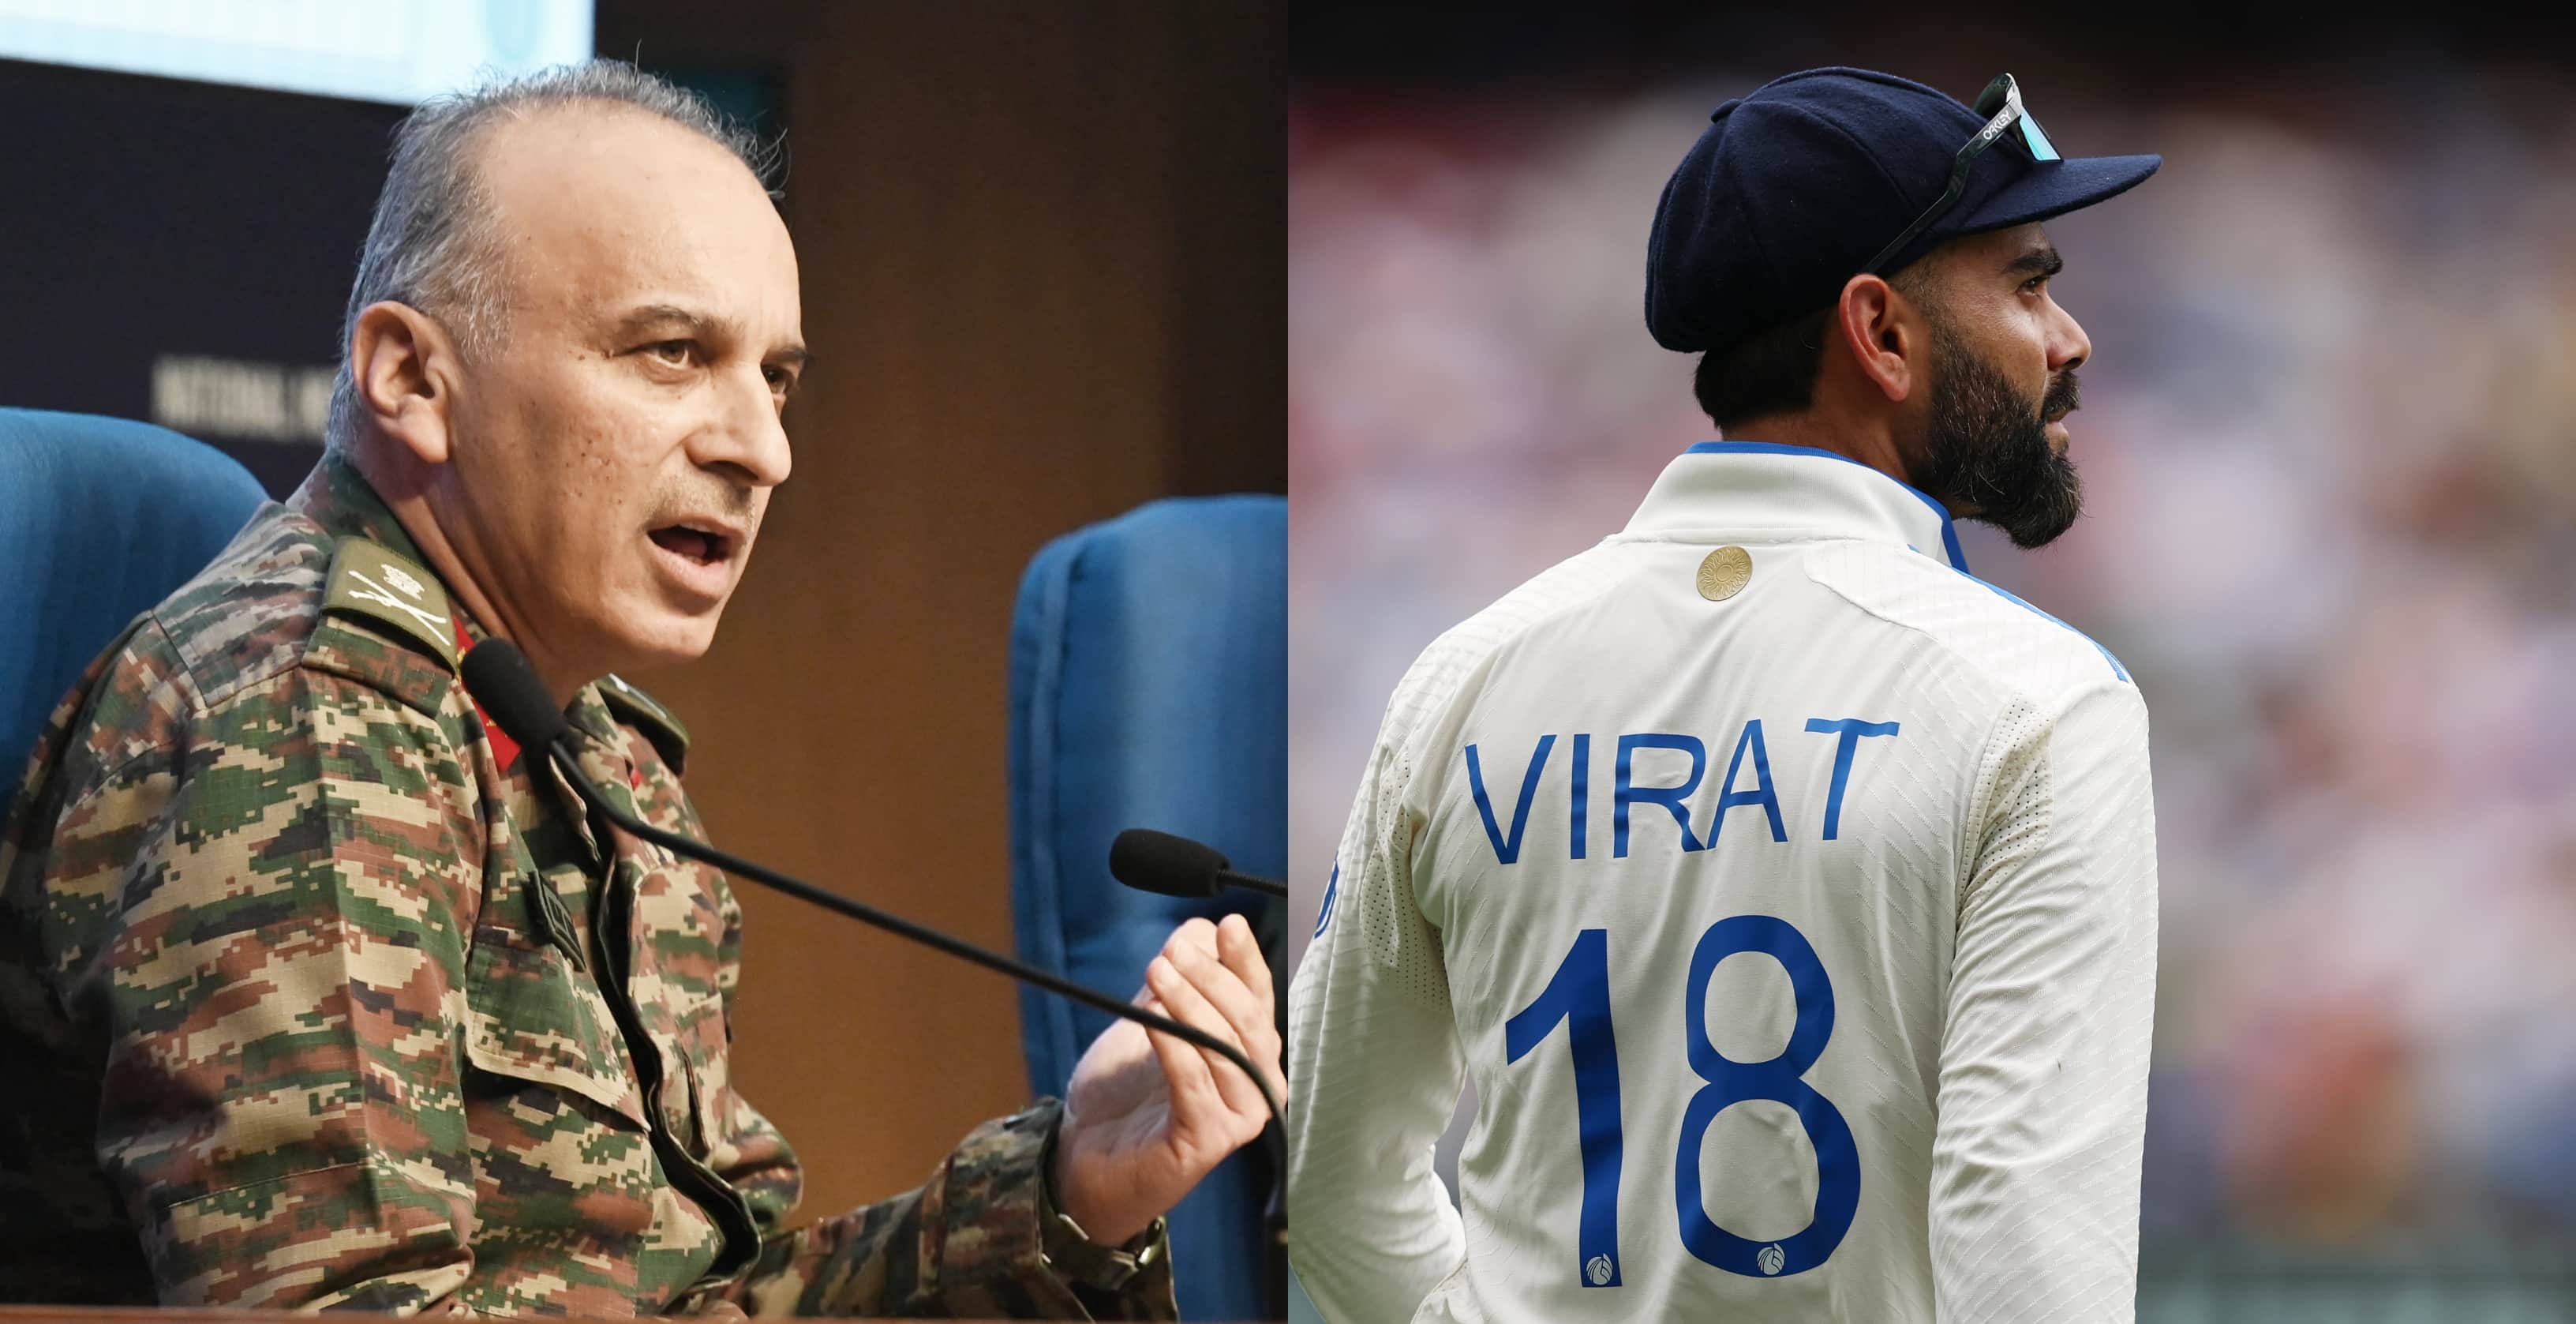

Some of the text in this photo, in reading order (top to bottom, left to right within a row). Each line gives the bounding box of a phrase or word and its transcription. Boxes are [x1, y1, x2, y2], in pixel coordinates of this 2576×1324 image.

[1983, 110, 2011, 140] OAKLEY
[1464, 718, 1900, 865] VIRAT
[1504, 914, 1861, 1288] 18
